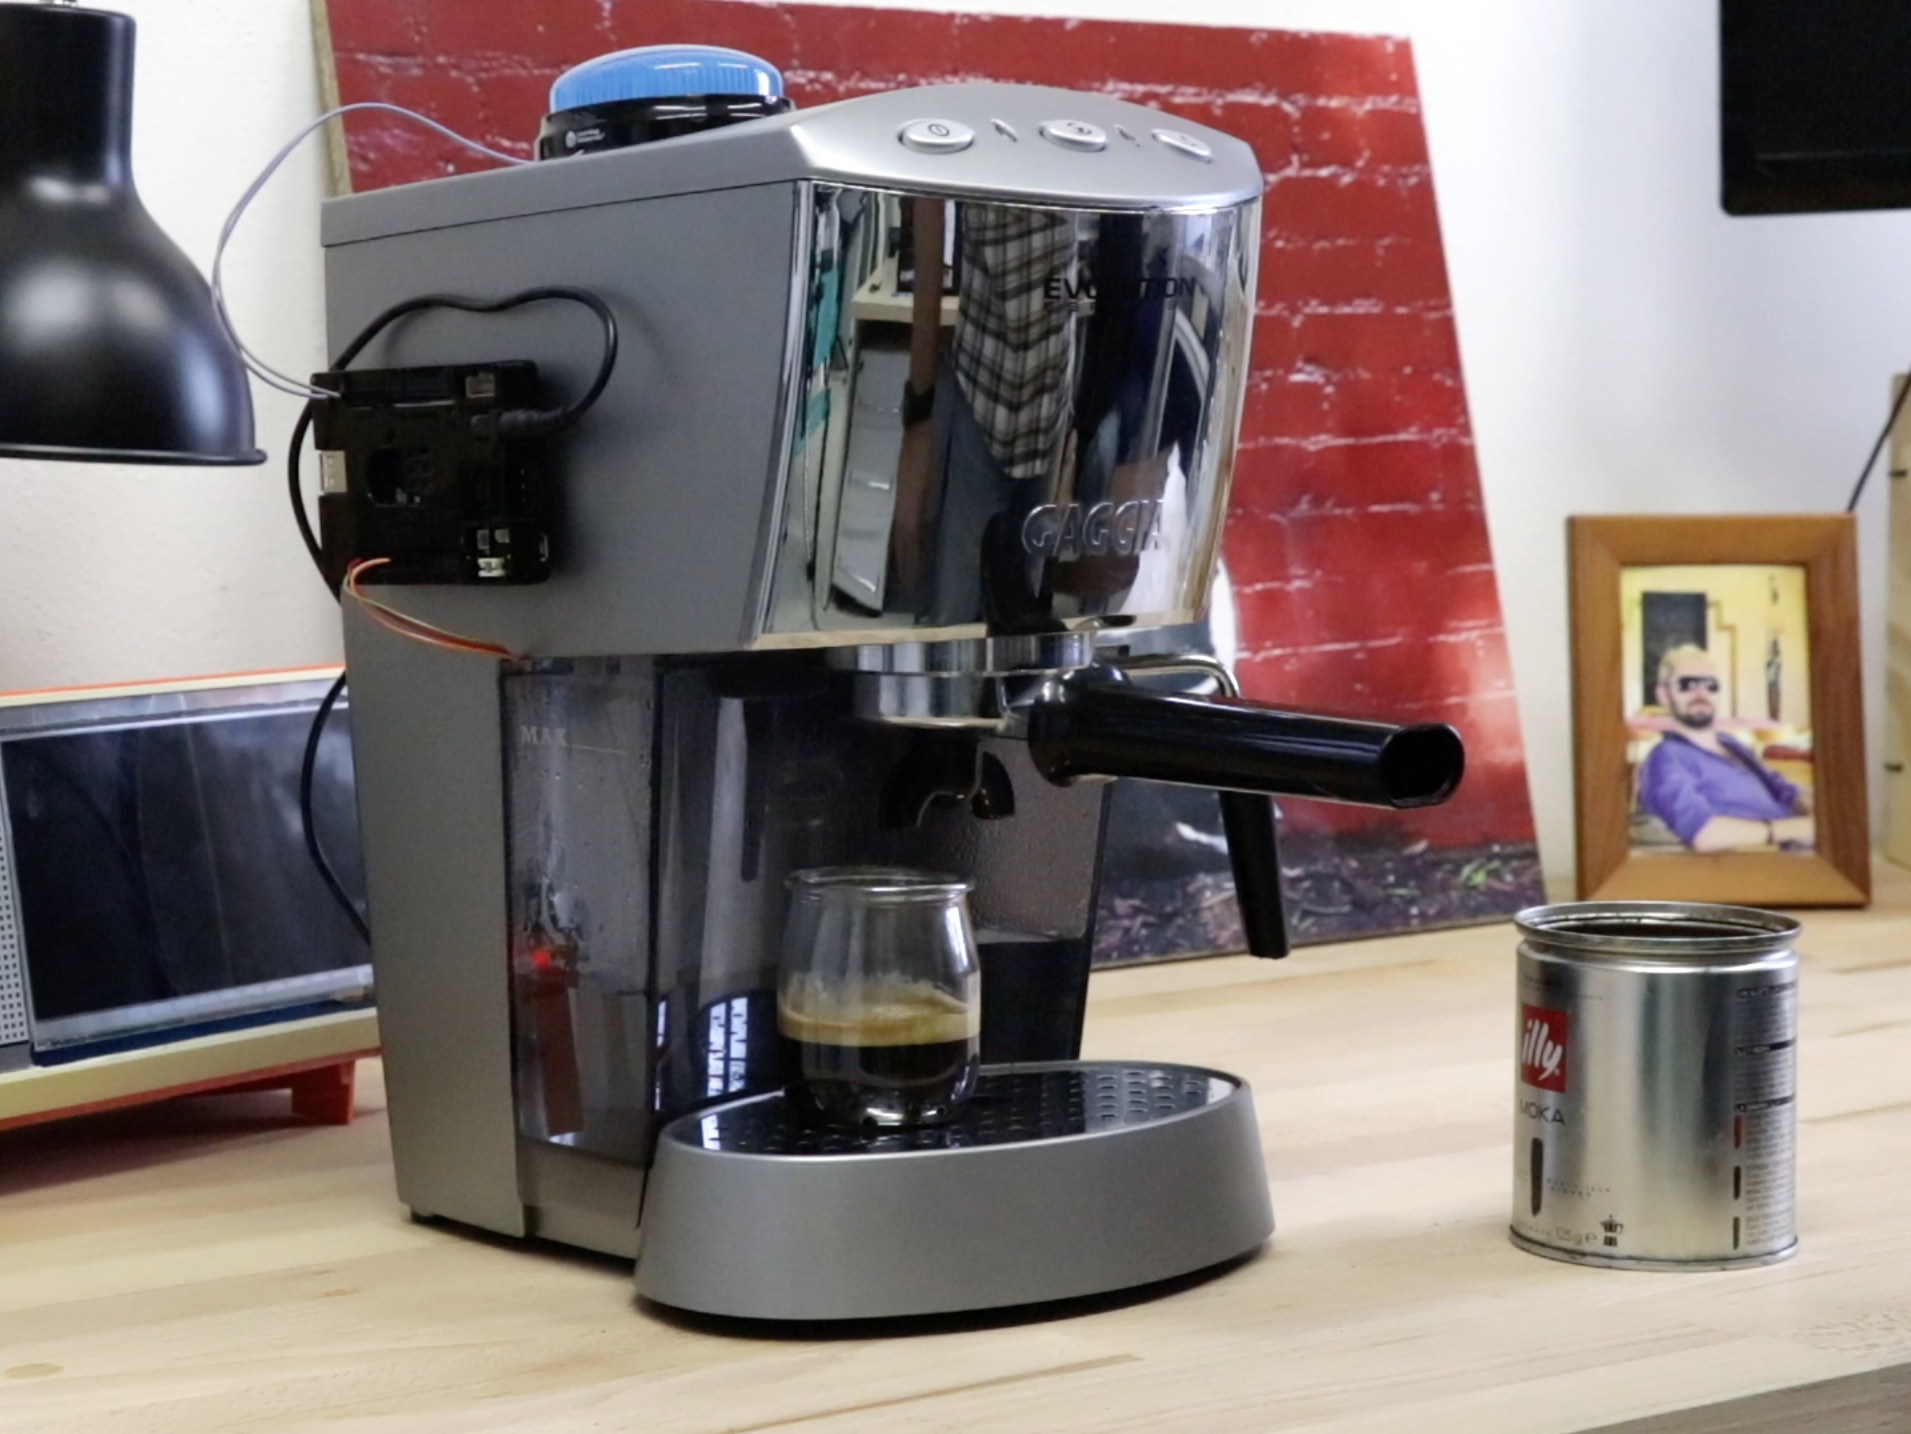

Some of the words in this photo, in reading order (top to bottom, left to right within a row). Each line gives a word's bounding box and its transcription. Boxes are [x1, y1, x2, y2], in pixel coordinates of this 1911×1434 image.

[1021, 499, 1162, 557] GAGGIA
[520, 724, 568, 747] MAX
[1522, 1018, 1563, 1081] illy
